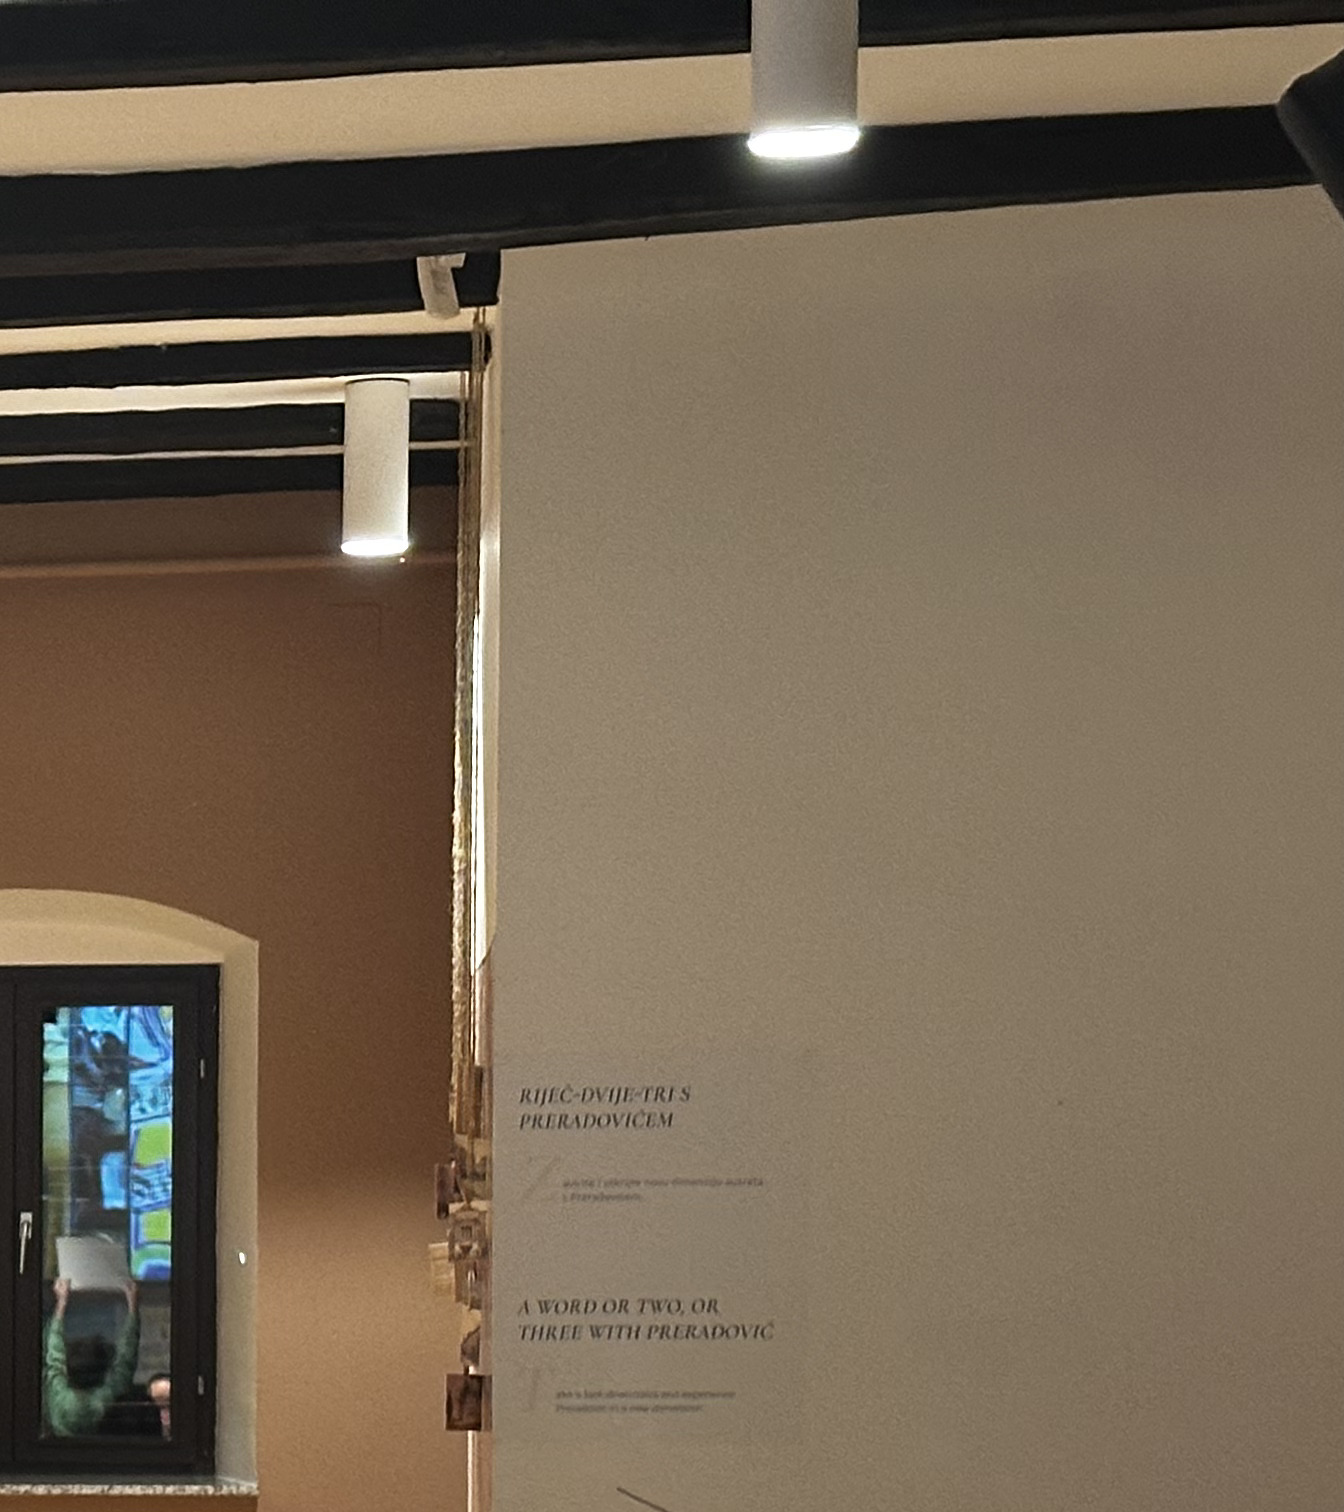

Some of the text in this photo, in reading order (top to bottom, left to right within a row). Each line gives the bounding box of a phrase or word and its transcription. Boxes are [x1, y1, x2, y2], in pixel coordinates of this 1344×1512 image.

[517, 1297, 721, 1318] A WORD OR TWO, OR
[518, 1323, 583, 1342] THREE
[589, 1323, 642, 1341] WITH
